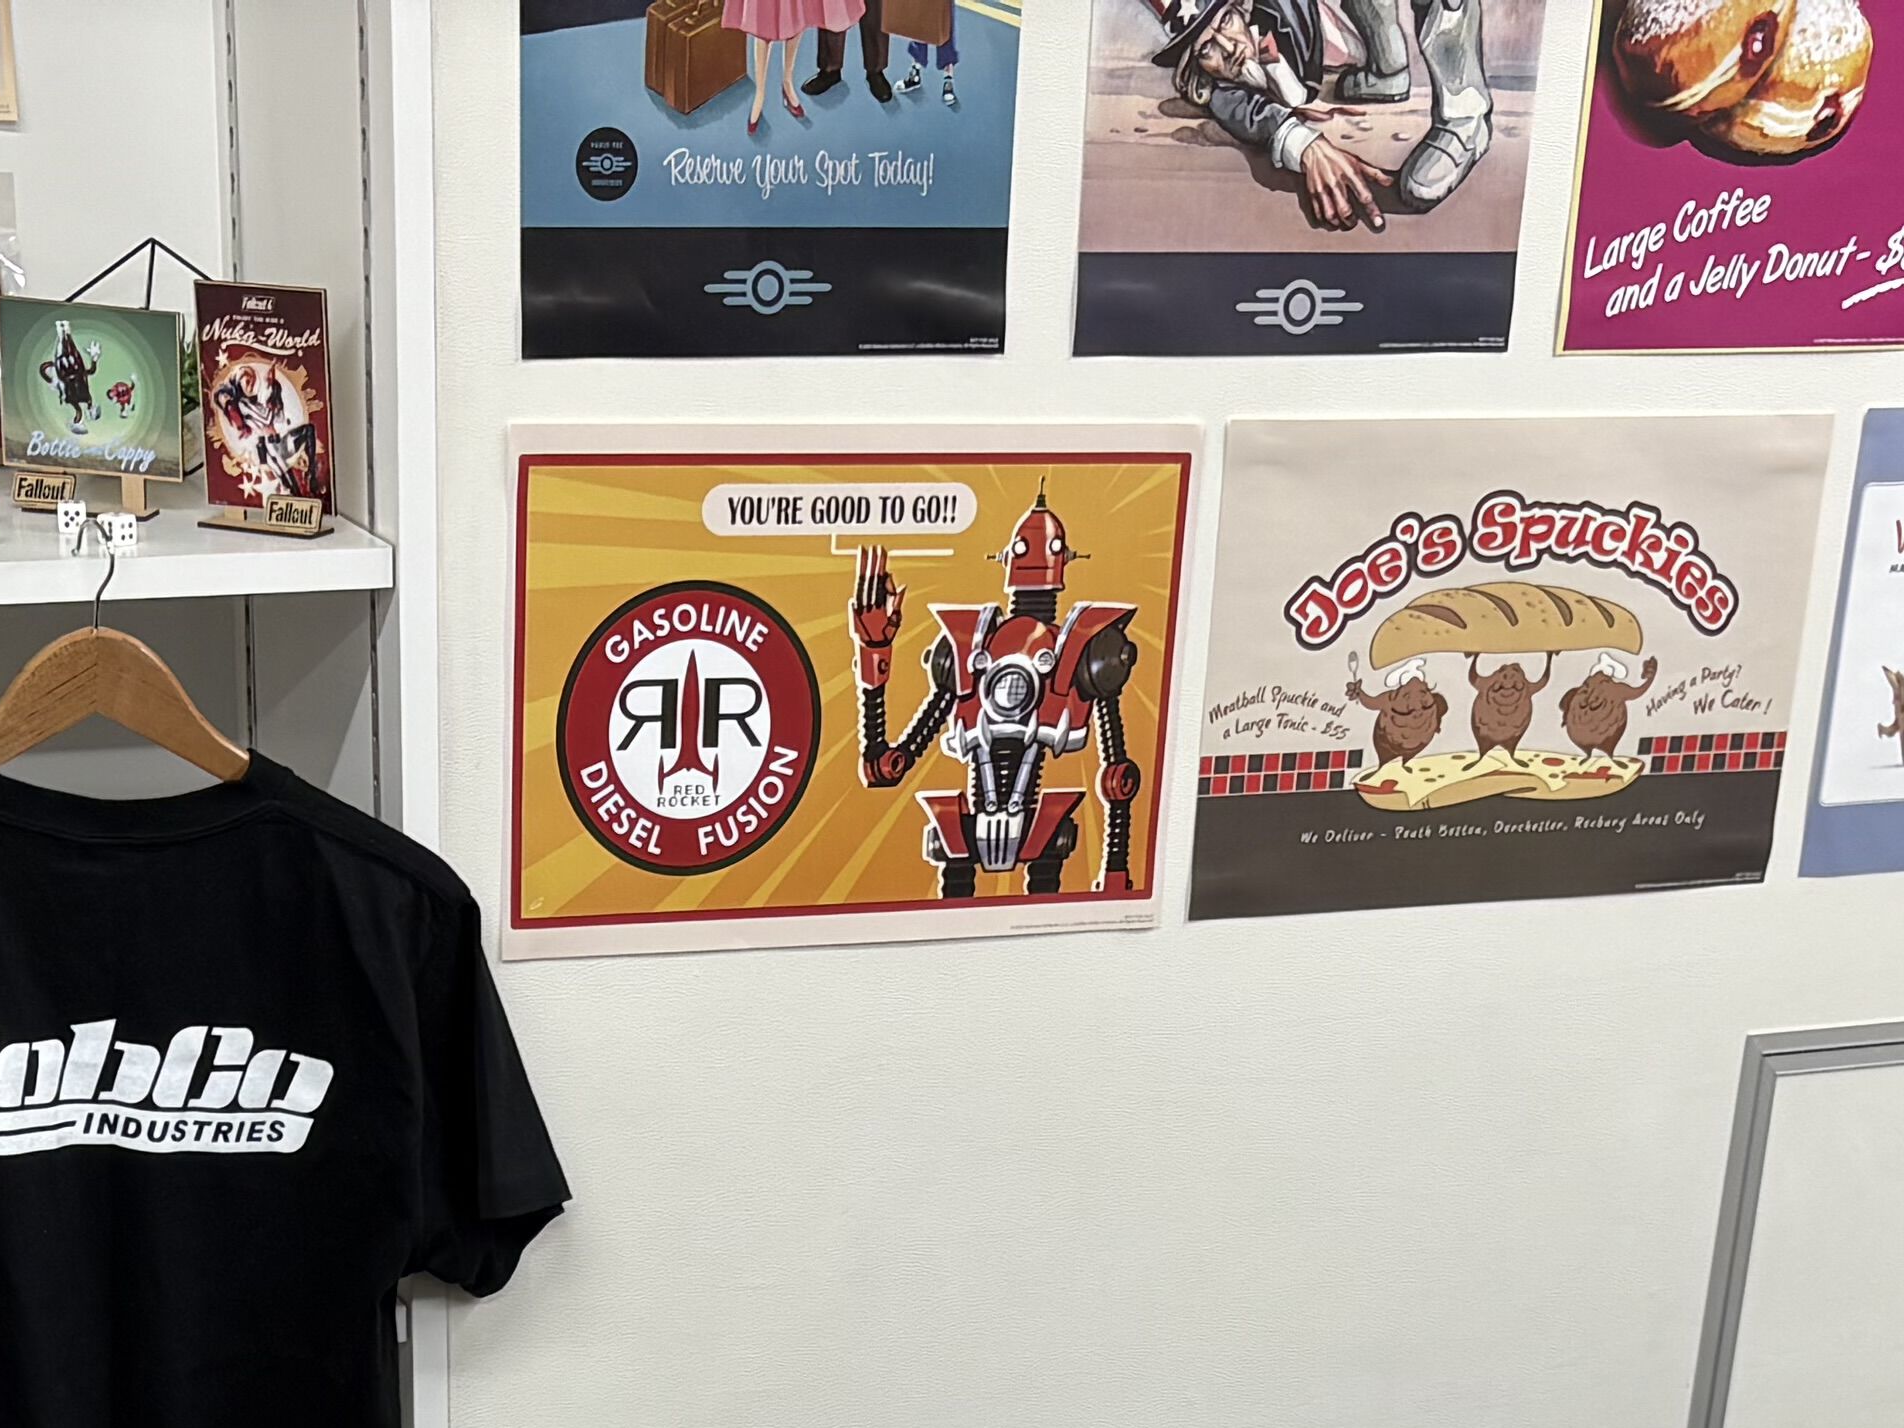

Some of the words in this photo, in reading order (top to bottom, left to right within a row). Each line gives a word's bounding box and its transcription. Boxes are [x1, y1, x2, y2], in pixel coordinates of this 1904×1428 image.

[663, 146, 747, 188] Reserve
[752, 151, 806, 200] Your
[815, 150, 862, 197] Spot
[867, 151, 935, 197] Today!
[1583, 221, 1665, 279] Large
[1672, 187, 1773, 243] Coffee
[1604, 264, 1665, 318] and
[1663, 275, 1686, 303] a
[1689, 255, 1761, 299] Jelly
[26, 430, 81, 459] Bottle
[104, 441, 157, 472] Cappy
[16, 477, 67, 501] Fallout
[267, 500, 314, 526] Fallout
[727, 494, 805, 527] YOU'RE
[809, 495, 871, 525] GOOD
[877, 495, 906, 524] TO
[910, 494, 958, 525] GO!!
[1283, 511, 1469, 651] Joe's
[1468, 489, 1741, 637] Spuckies
[603, 602, 772, 666] GASOLINE
[1208, 685, 1267, 725] Meatball
[1270, 685, 1319, 711] Spuckie
[1320, 701, 1347, 718] and
[1645, 679, 1688, 718] Having
[1689, 675, 1698, 688] a
[1700, 663, 1743, 688] Party?
[1692, 692, 1716, 716] We
[1222, 728, 1231, 740] a
[1235, 717, 1272, 739] Large
[1276, 712, 1309, 733] Tonic
[578, 758, 664, 857] DIESEL
[696, 744, 800, 856] FUSION
[656, 794, 721, 808] ROCKET
[673, 784, 705, 796] RED
[82, 1112, 286, 1144] INDUSTRIES
